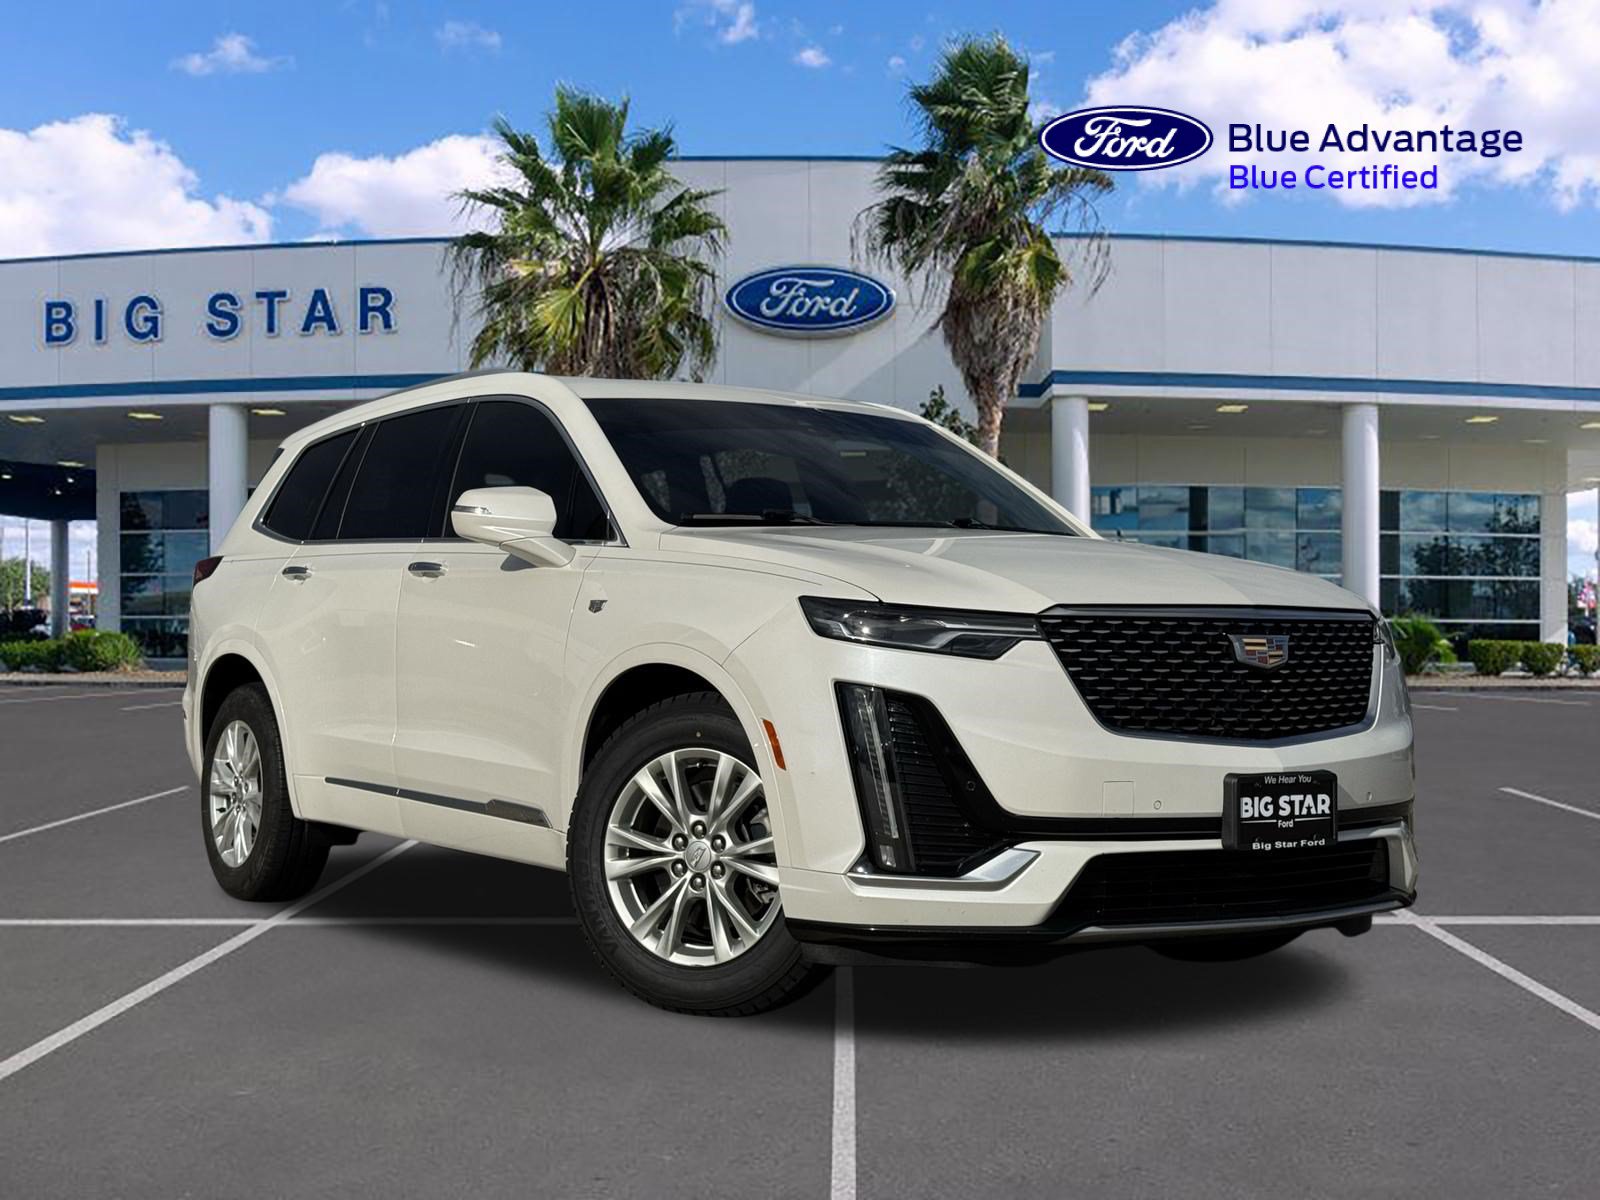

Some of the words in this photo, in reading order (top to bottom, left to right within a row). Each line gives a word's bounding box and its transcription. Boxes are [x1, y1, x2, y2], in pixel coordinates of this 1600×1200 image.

[760, 277, 859, 317] Ford
[44, 295, 163, 345] BIG
[206, 286, 397, 341] STAR
[1264, 775, 1277, 784] We
[1278, 775, 1297, 784] Hear
[1297, 774, 1312, 783] You
[1240, 796, 1273, 818] BIG
[1278, 793, 1331, 816] STAR
[1277, 820, 1294, 828] Ford
[1252, 841, 1272, 850] Big
[1274, 840, 1298, 848] Star
[1300, 838, 1326, 847] Ford
